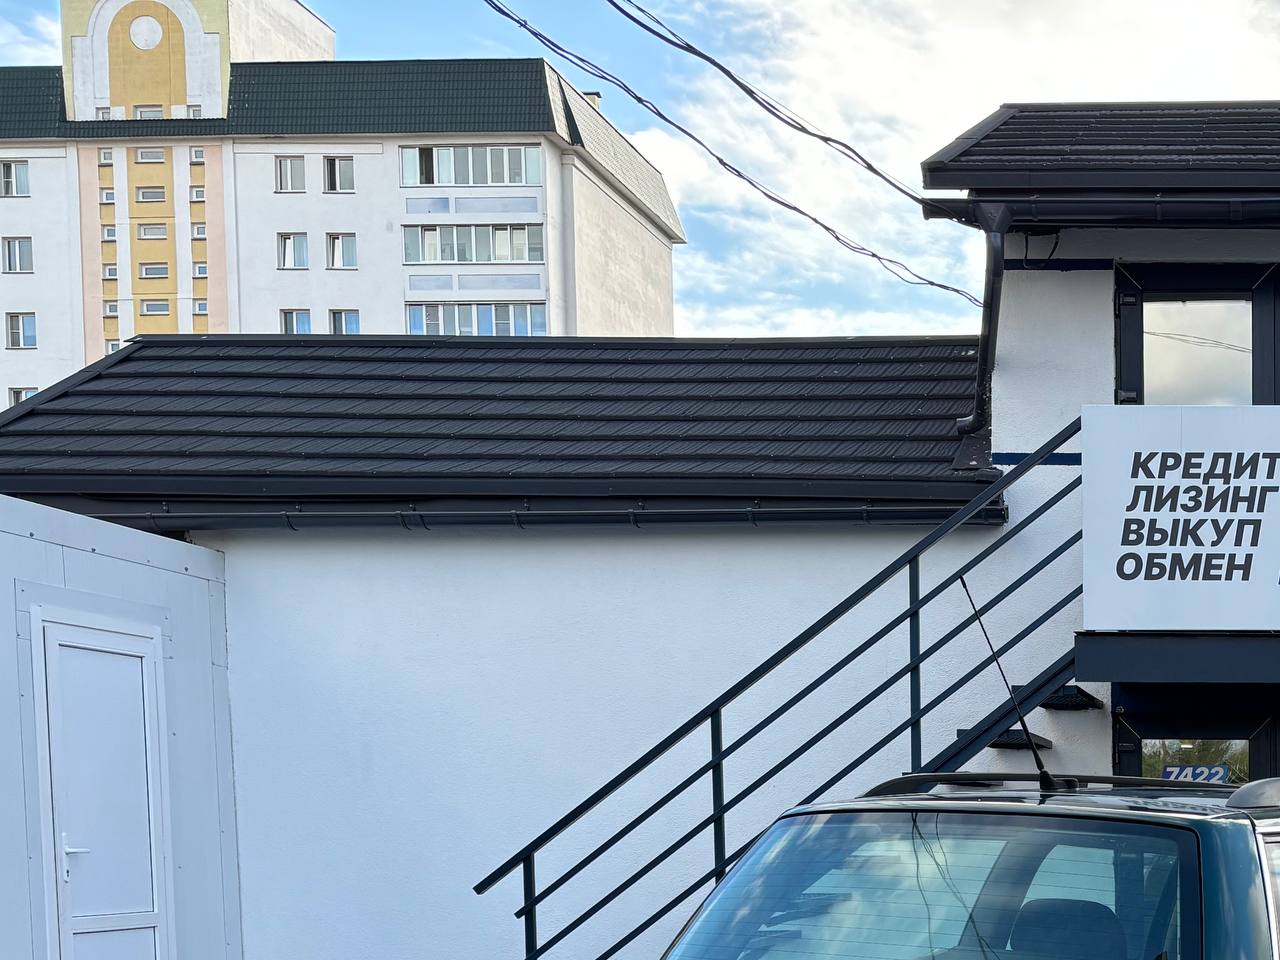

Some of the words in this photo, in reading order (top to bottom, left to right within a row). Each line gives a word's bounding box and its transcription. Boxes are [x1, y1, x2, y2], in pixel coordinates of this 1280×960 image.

[1125, 484, 1280, 513] ЛИЗИНГ
[1120, 518, 1263, 547] ВЫКУП
[1115, 552, 1254, 582] ОБМЕН
[1164, 766, 1226, 784] 7422
